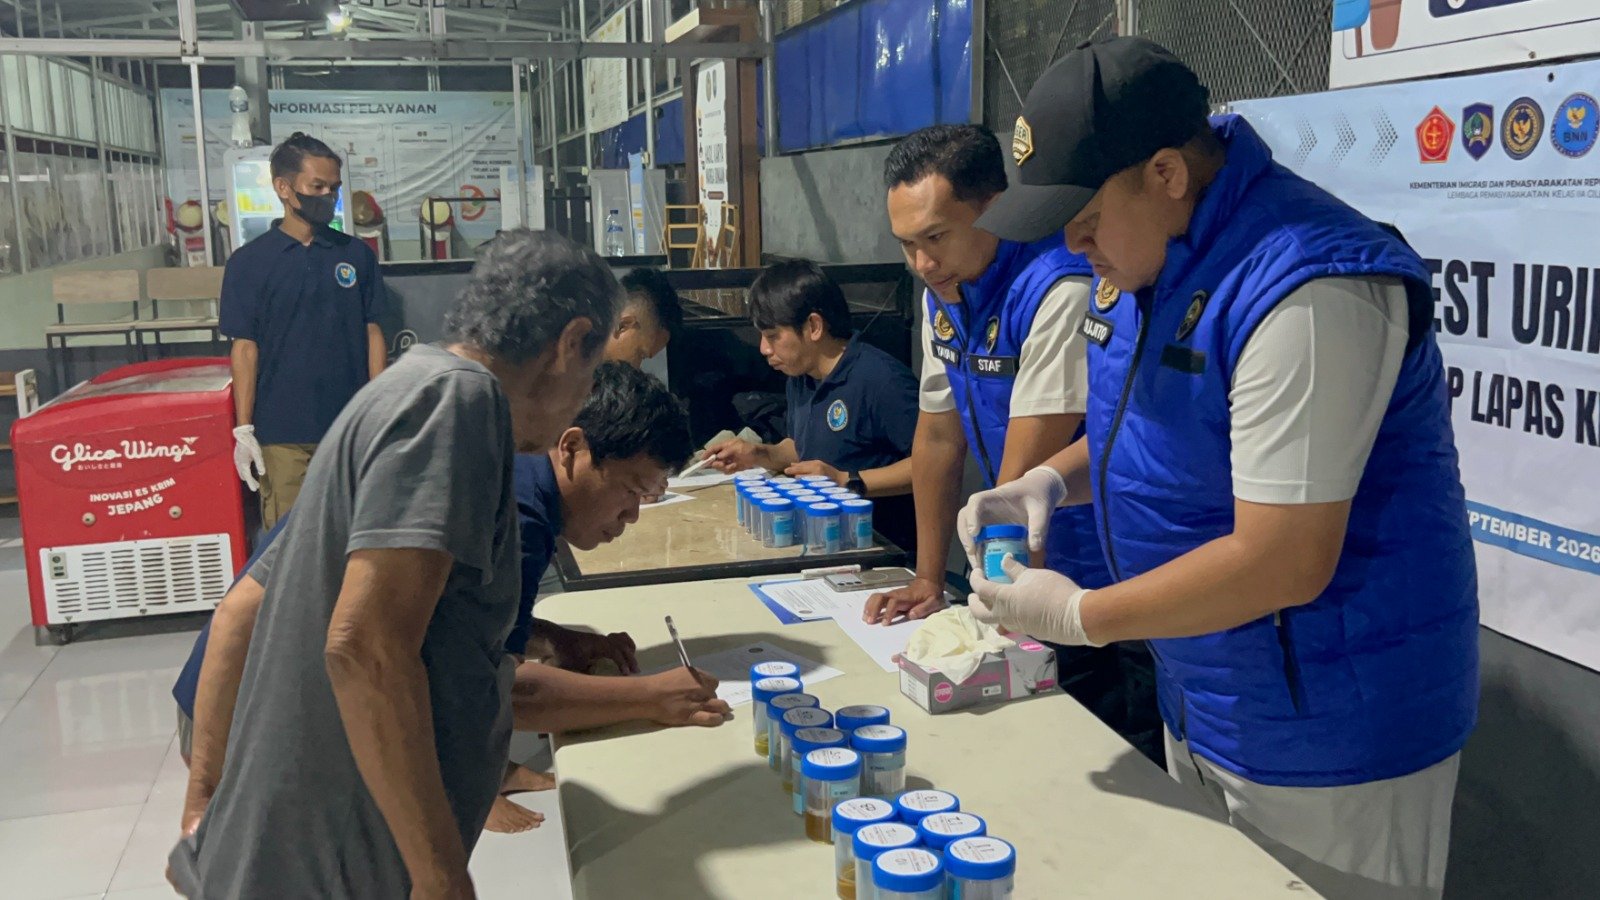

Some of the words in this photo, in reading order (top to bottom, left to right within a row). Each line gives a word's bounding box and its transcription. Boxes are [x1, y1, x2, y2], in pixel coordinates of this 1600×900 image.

[270, 103, 345, 114] NFORMASI
[350, 104, 437, 114] PELAYANAN
[1563, 131, 1588, 143] BNN
[1409, 181, 1457, 189] KEMENTERIAN
[1489, 180, 1504, 188] DAN
[1505, 179, 1582, 187] PEMASYARAKATAN
[1584, 178, 1600, 186] REP
[1552, 190, 1575, 198] KELAS
[1423, 258, 1495, 339] EST
[977, 358, 1001, 372] STAF
[1447, 366, 1464, 417] P
[1471, 370, 1565, 439] LAPAS
[1575, 388, 1600, 448] K
[51, 442, 122, 471] Glico
[120, 440, 196, 462] Wings
[89, 490, 133, 502] INOVASI
[135, 487, 149, 497] ES
[150, 477, 176, 493] KRIM
[108, 493, 163, 516] JEPANG
[1467, 509, 1552, 549] PTEMBER
[1556, 536, 1600, 563] 2026
